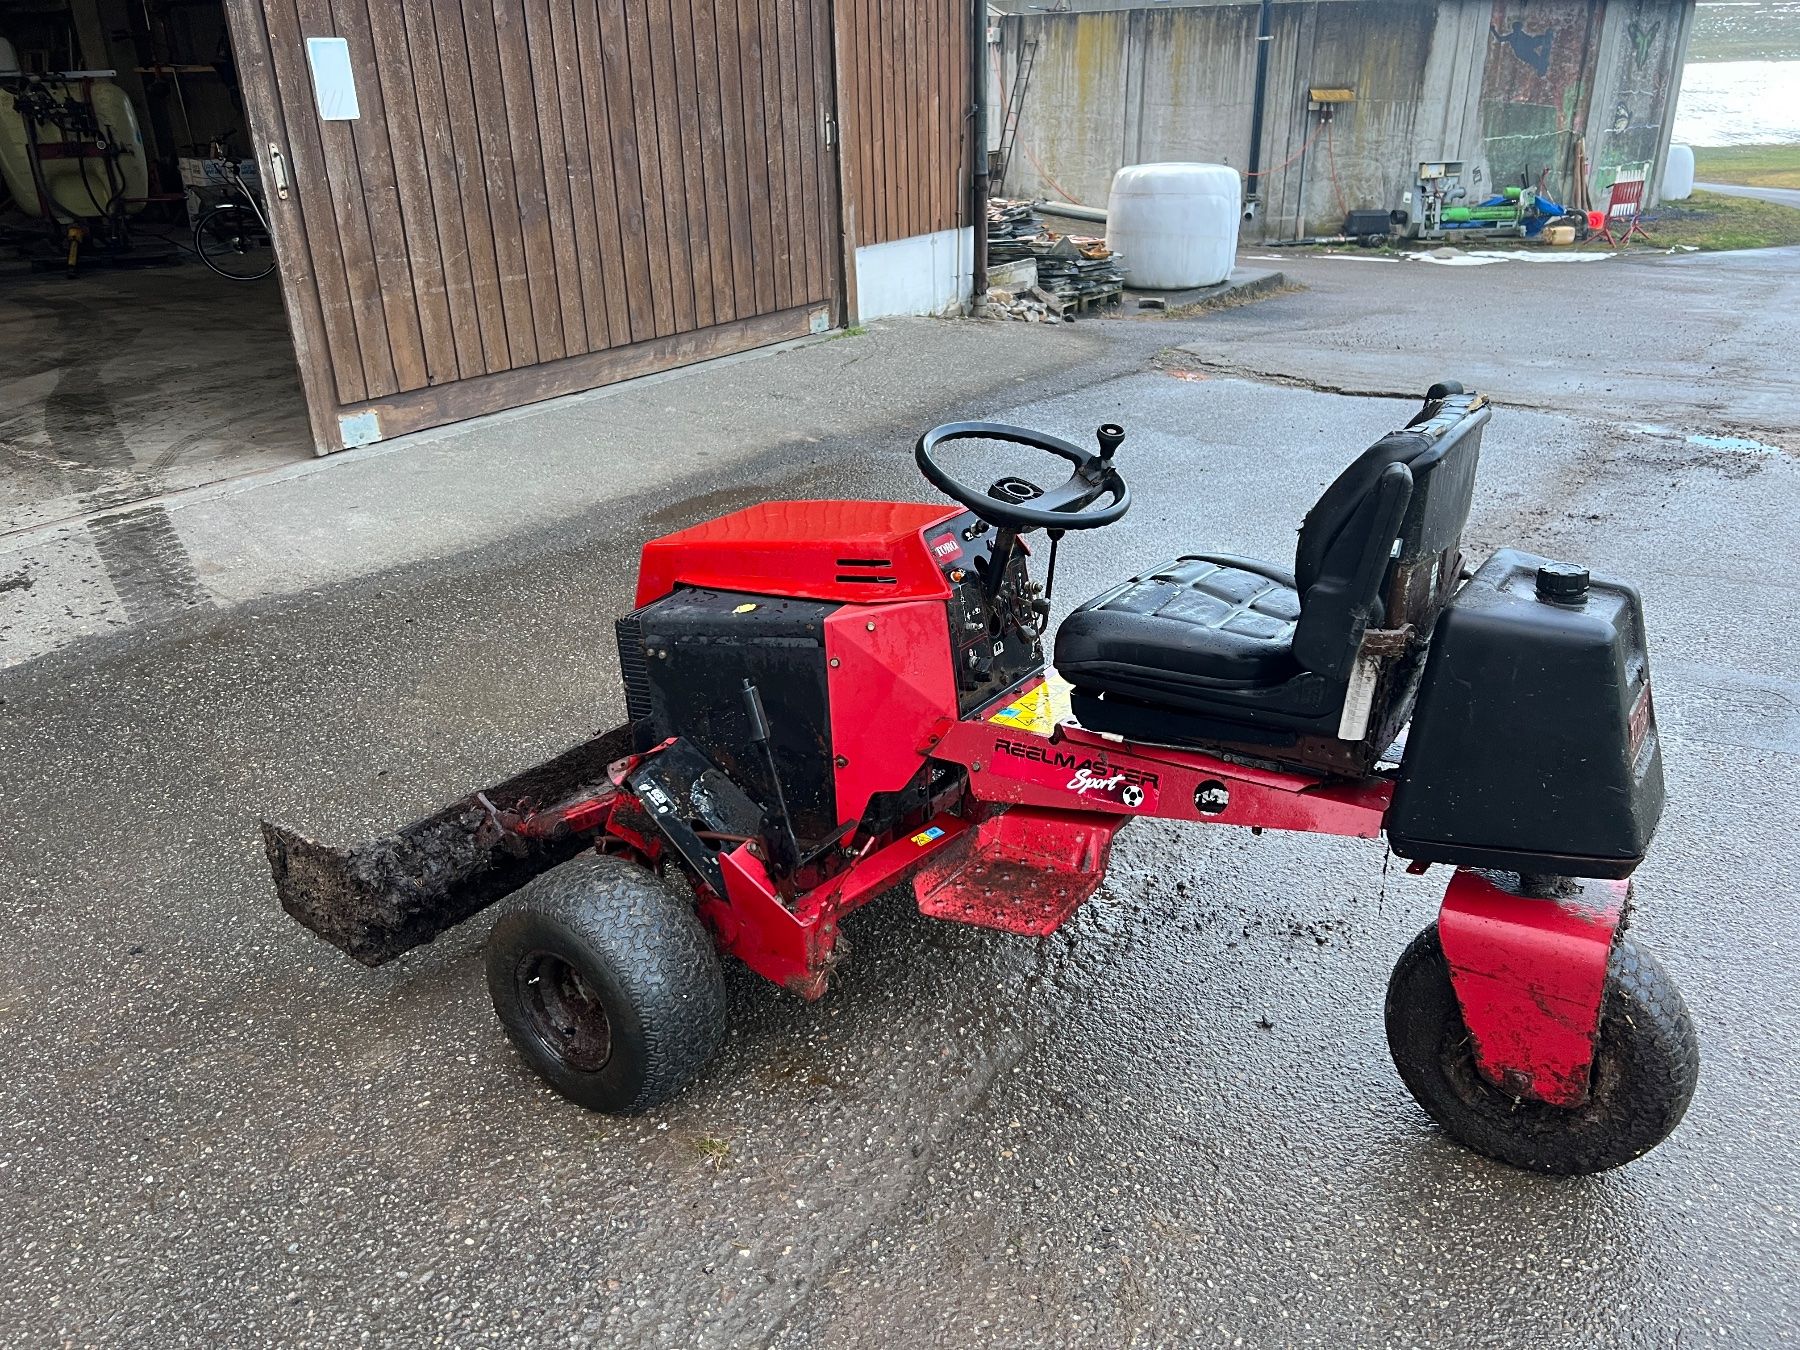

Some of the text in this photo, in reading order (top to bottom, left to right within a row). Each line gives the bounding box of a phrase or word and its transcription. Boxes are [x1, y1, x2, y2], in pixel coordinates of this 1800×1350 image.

[934, 540, 959, 557] TORO
[994, 738, 1159, 789] REELMASTER
[1066, 768, 1126, 795] Sport
